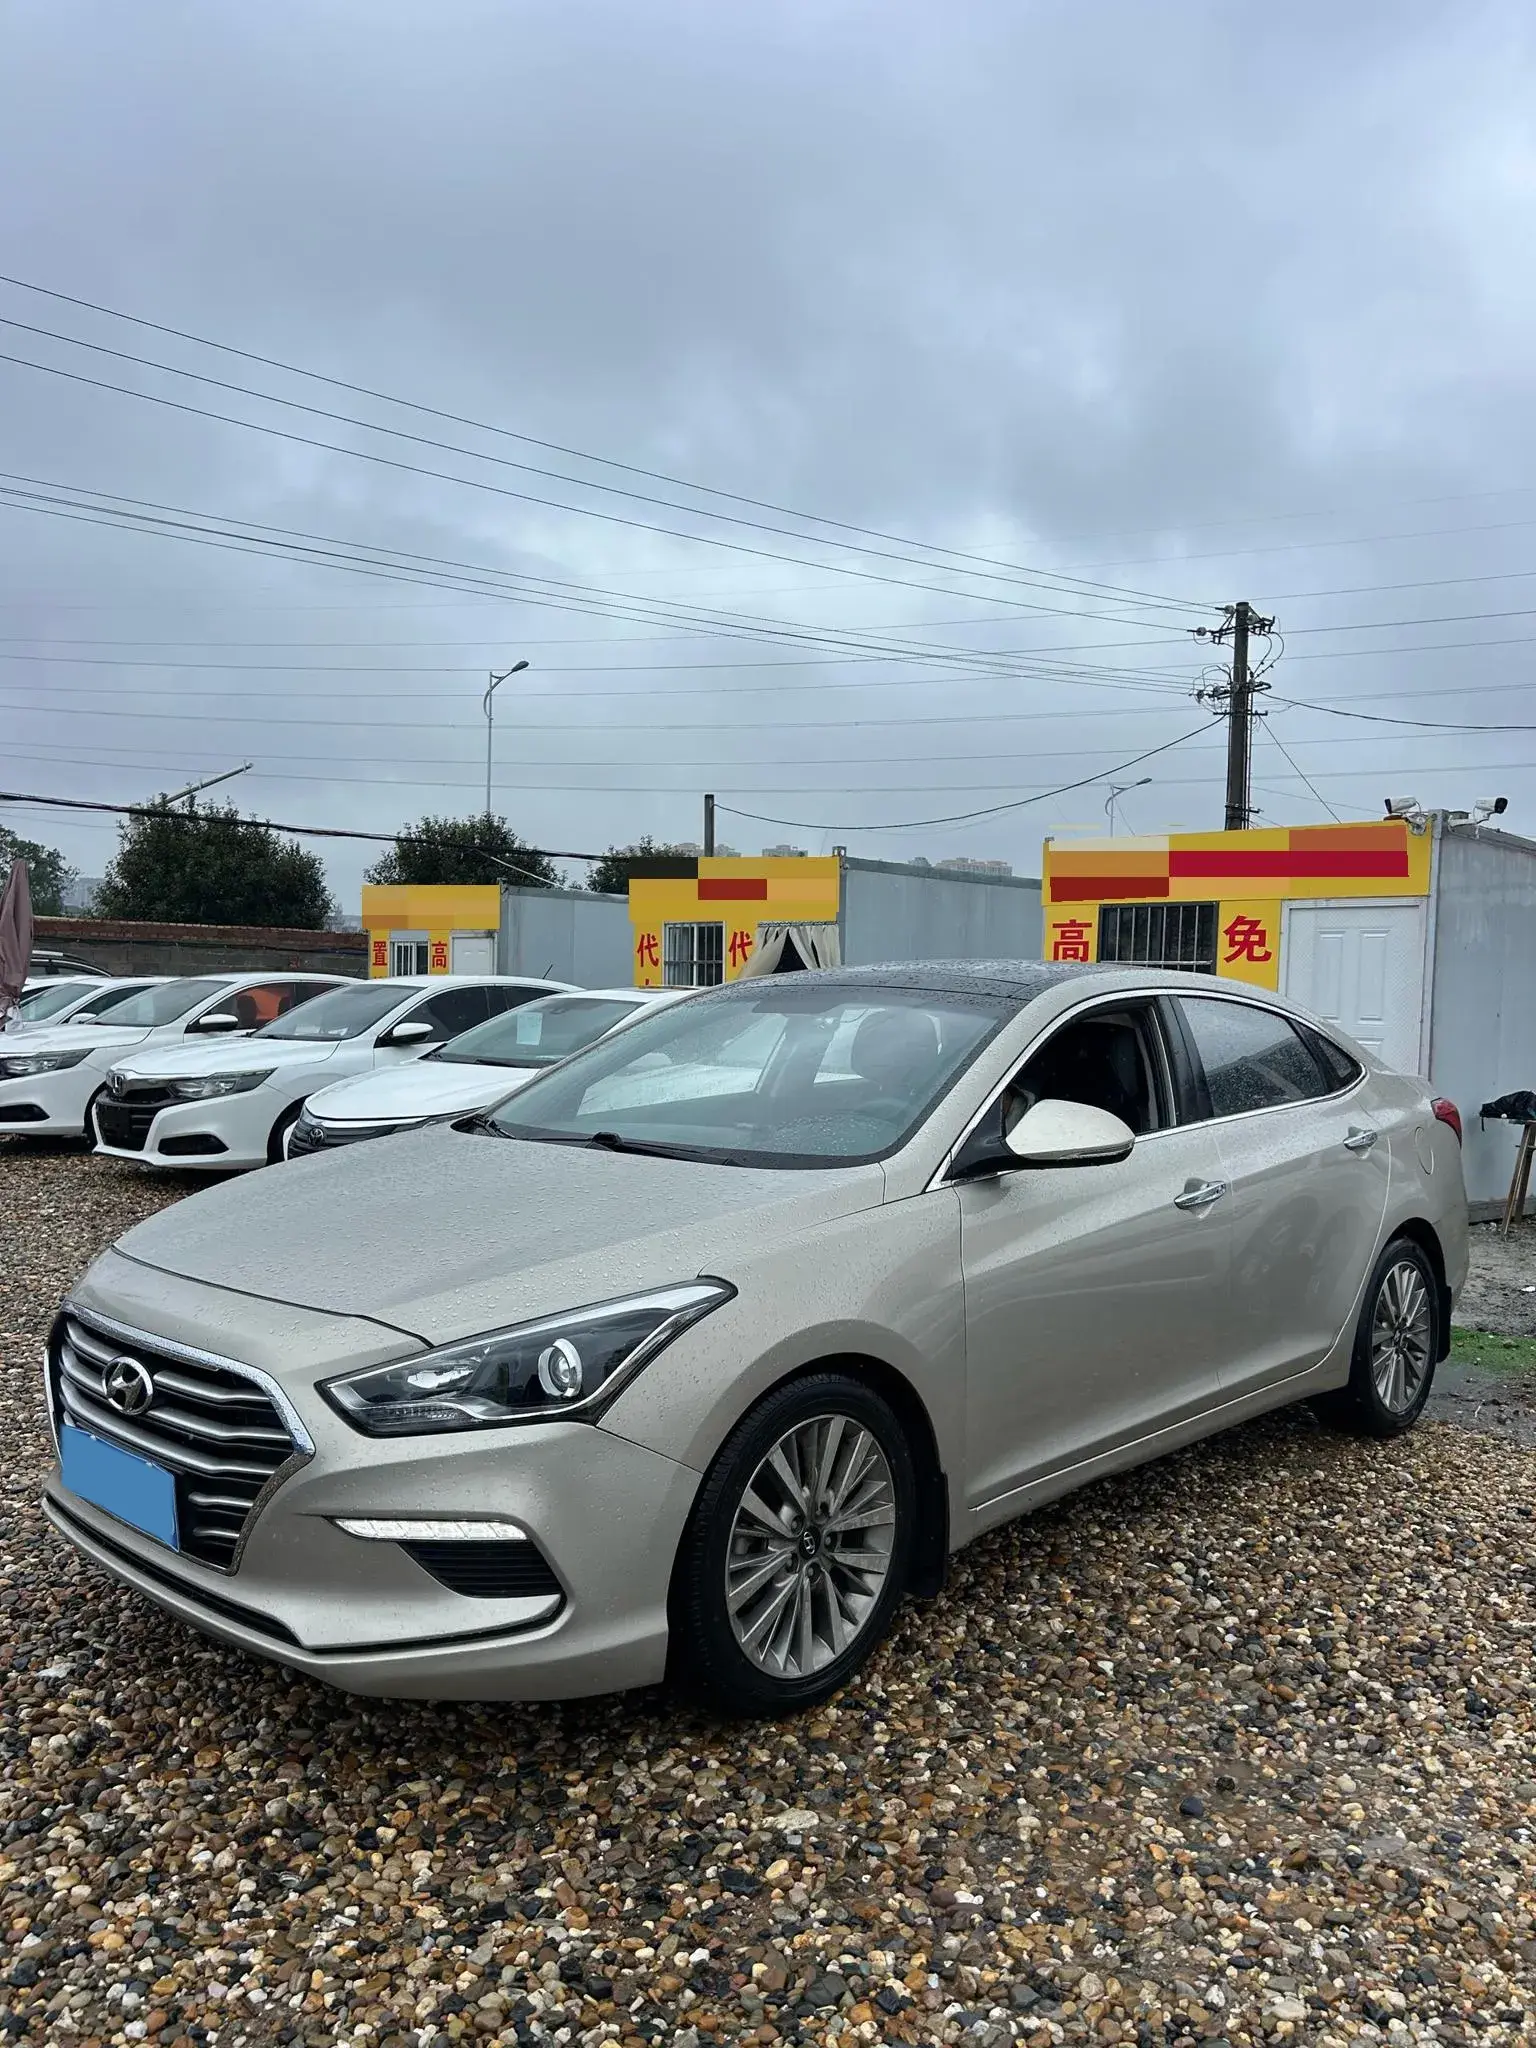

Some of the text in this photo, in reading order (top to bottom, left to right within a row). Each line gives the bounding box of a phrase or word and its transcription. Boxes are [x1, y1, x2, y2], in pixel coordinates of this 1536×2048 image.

[431, 941, 448, 968] 高
[637, 933, 660, 968] 代
[1052, 919, 1093, 962] 高
[1222, 915, 1273, 963] 免
